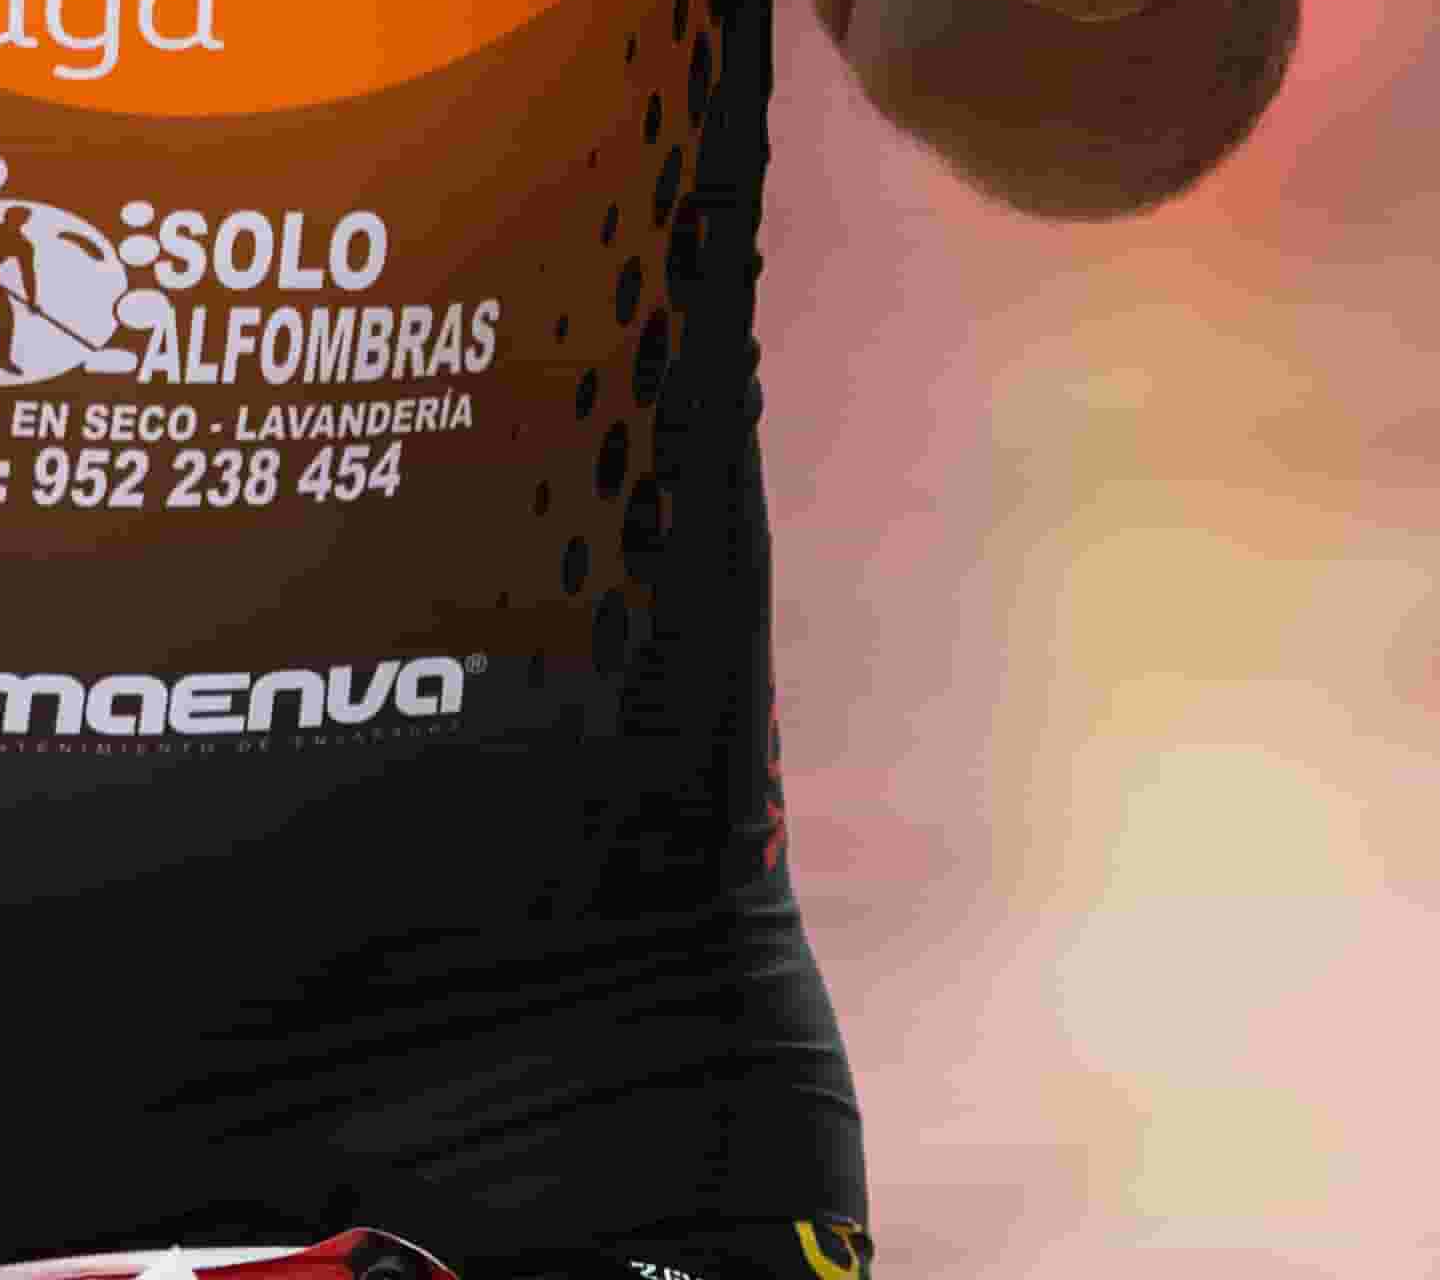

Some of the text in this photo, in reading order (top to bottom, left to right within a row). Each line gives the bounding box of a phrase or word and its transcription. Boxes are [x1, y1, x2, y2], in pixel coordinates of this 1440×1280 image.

[154, 209, 388, 290] SOLO
[138, 298, 501, 384] ALFOMBRAS
[11, 401, 70, 439] EN
[82, 402, 198, 443] SECO
[235, 387, 474, 442] LAVANDERÍA
[32, 447, 149, 508] 952
[166, 447, 280, 508] 238
[296, 440, 404, 502] 454
